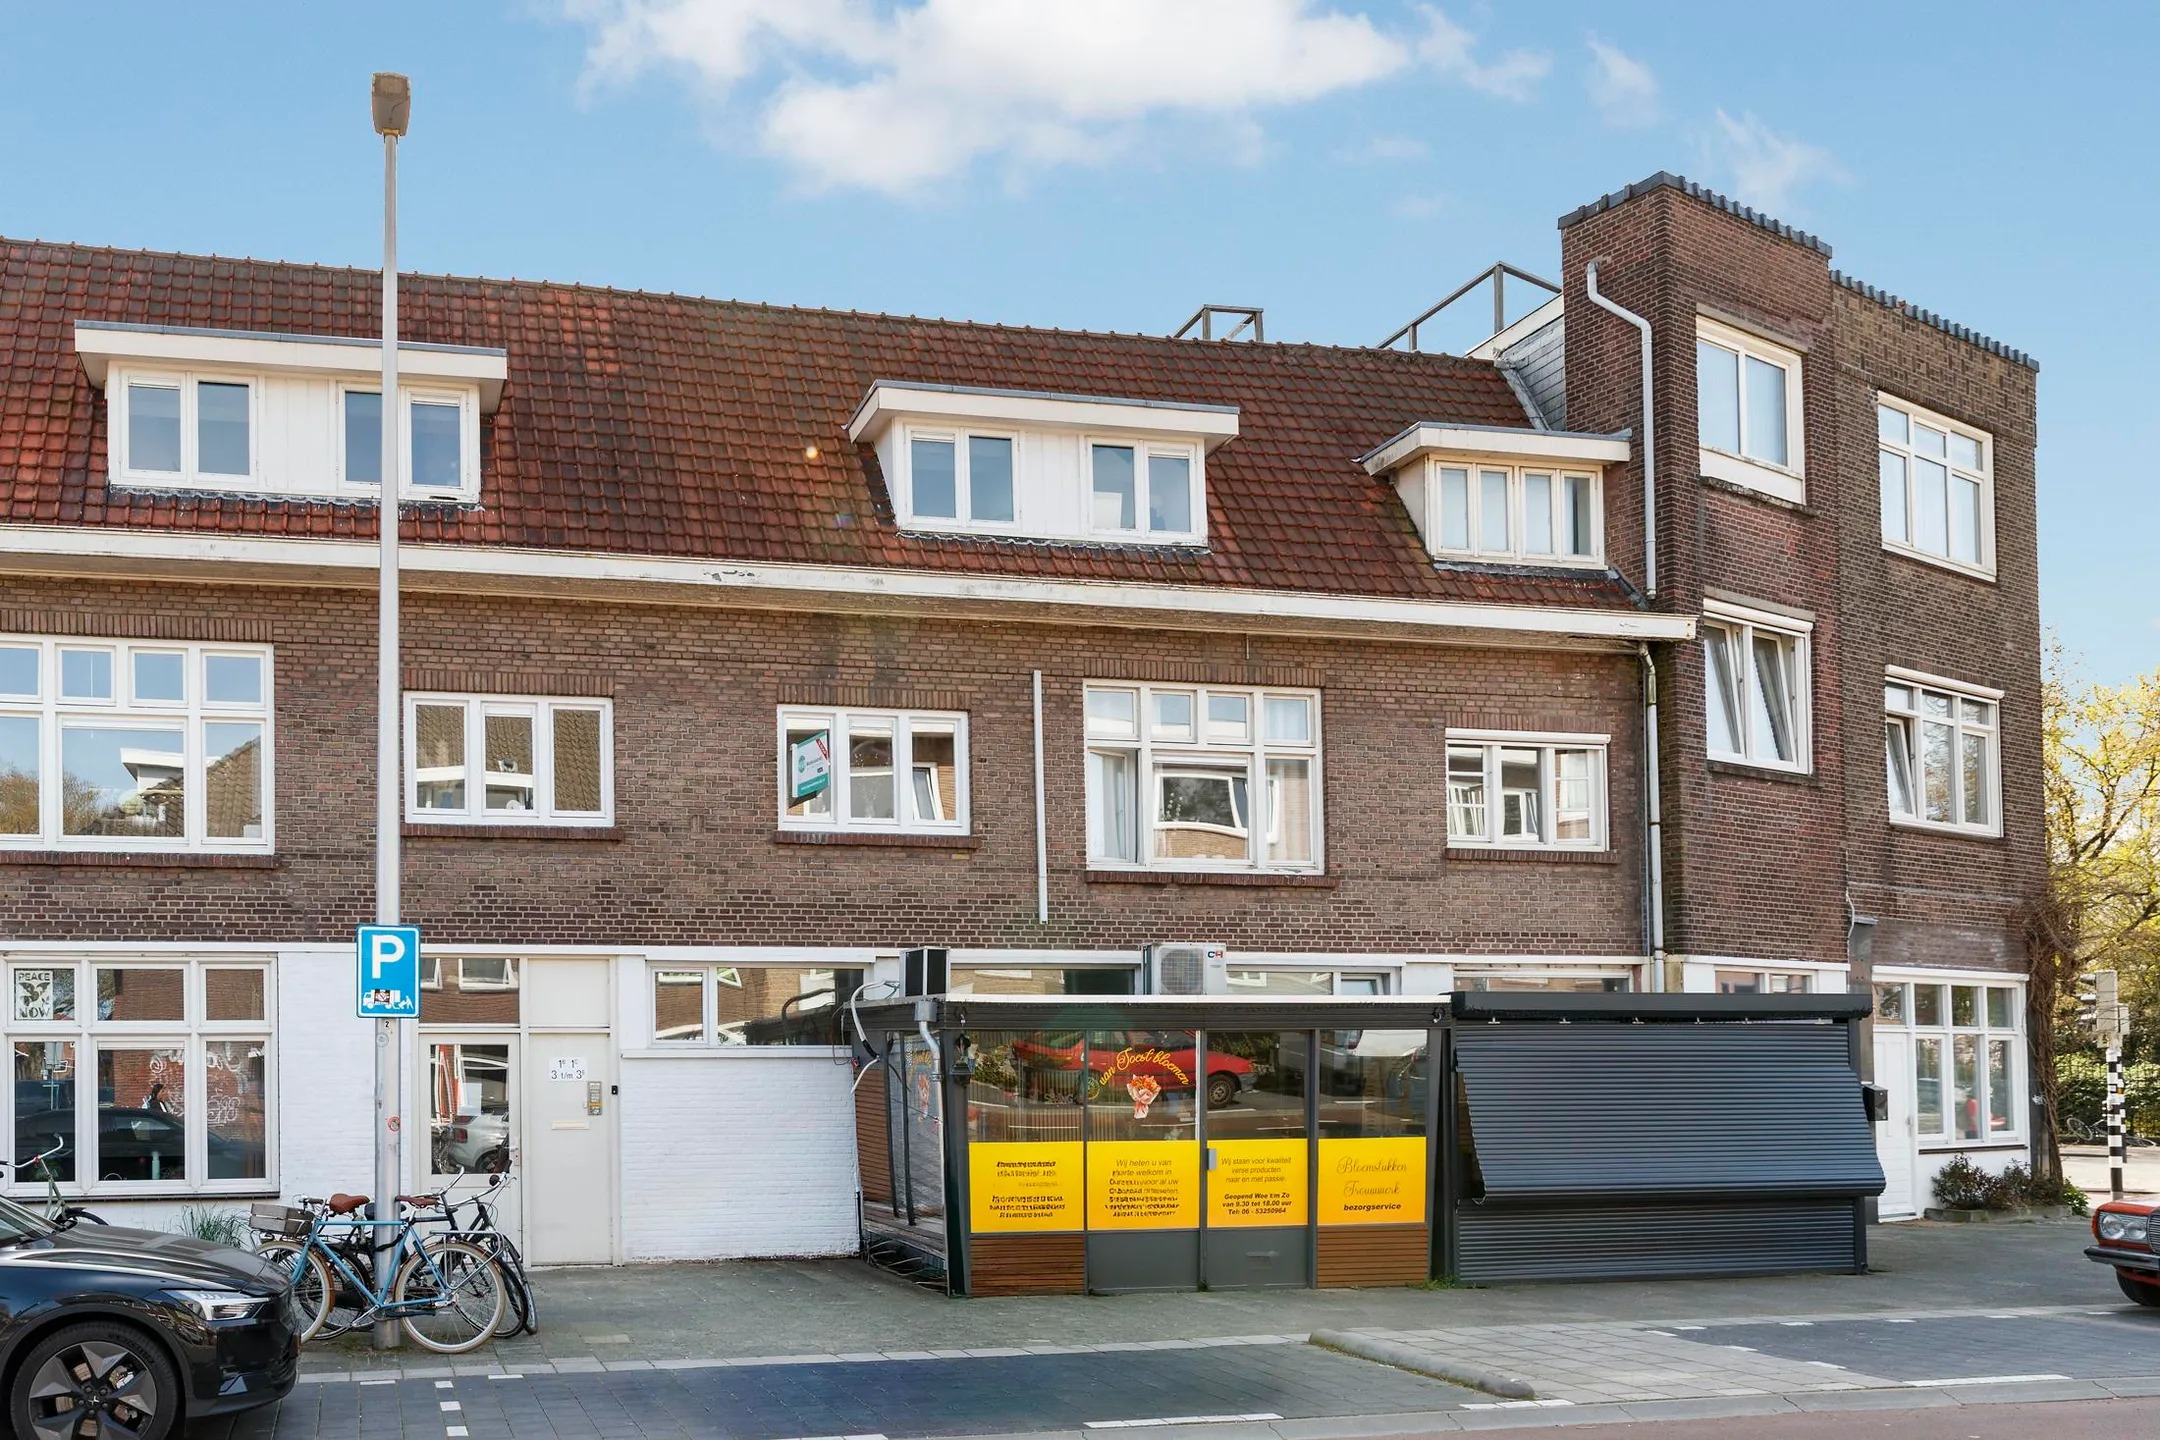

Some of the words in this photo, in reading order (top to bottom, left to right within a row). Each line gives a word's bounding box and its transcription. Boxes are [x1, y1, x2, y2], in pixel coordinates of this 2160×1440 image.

[371, 934, 406, 979] P
[1207, 950, 1224, 959] CH
[18, 972, 51, 981] PEACE
[19, 1006, 51, 1018] NOW
[1152, 1051, 1189, 1085] bloemen
[551, 1069, 558, 1080] 3
[1129, 1159, 1150, 1167] heten
[1136, 1168, 1164, 1176] welkom
[1343, 1202, 1402, 1212] bezorgservice
